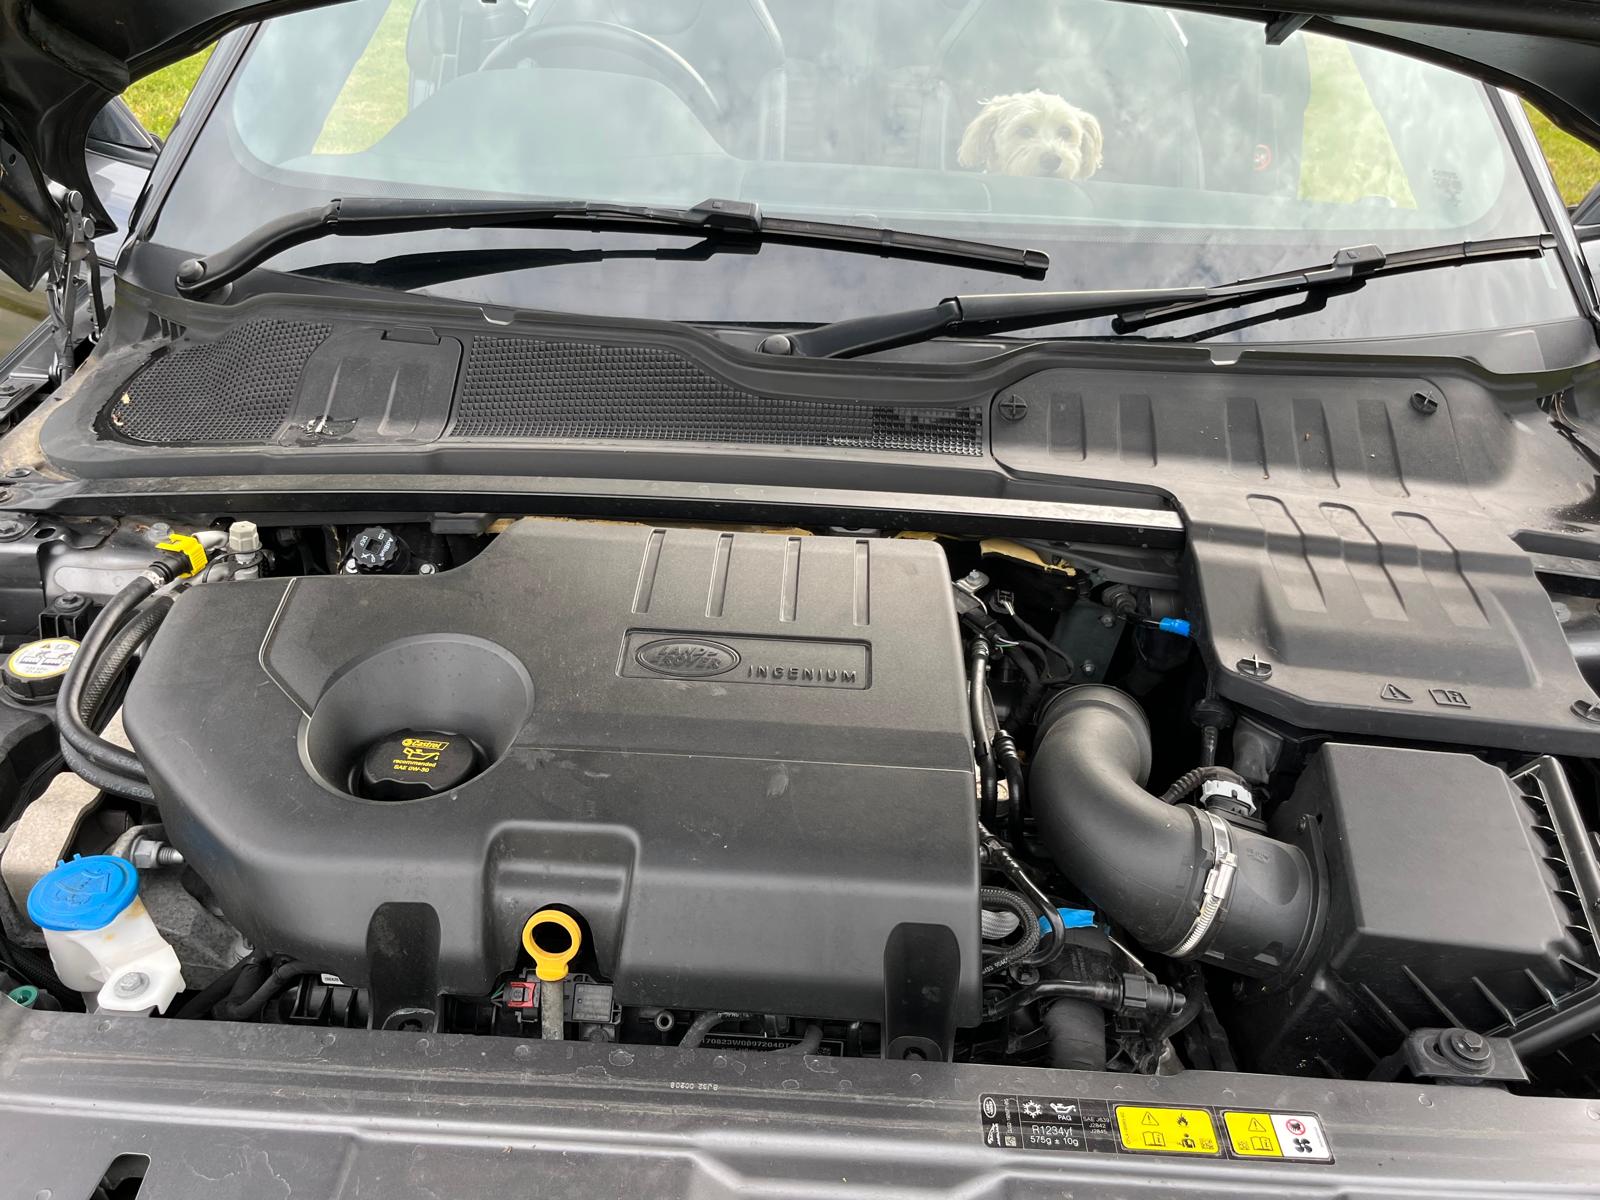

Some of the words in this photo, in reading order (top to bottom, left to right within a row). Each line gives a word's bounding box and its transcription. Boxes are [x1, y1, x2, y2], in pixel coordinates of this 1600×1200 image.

[747, 664, 857, 683] INGENIUM
[411, 740, 442, 749] Castrol
[392, 759, 437, 768] recommended
[1031, 1124, 1073, 1137] R1234yf
[1030, 1135, 1052, 1146] 575g
[1063, 1137, 1079, 1147] 10g
